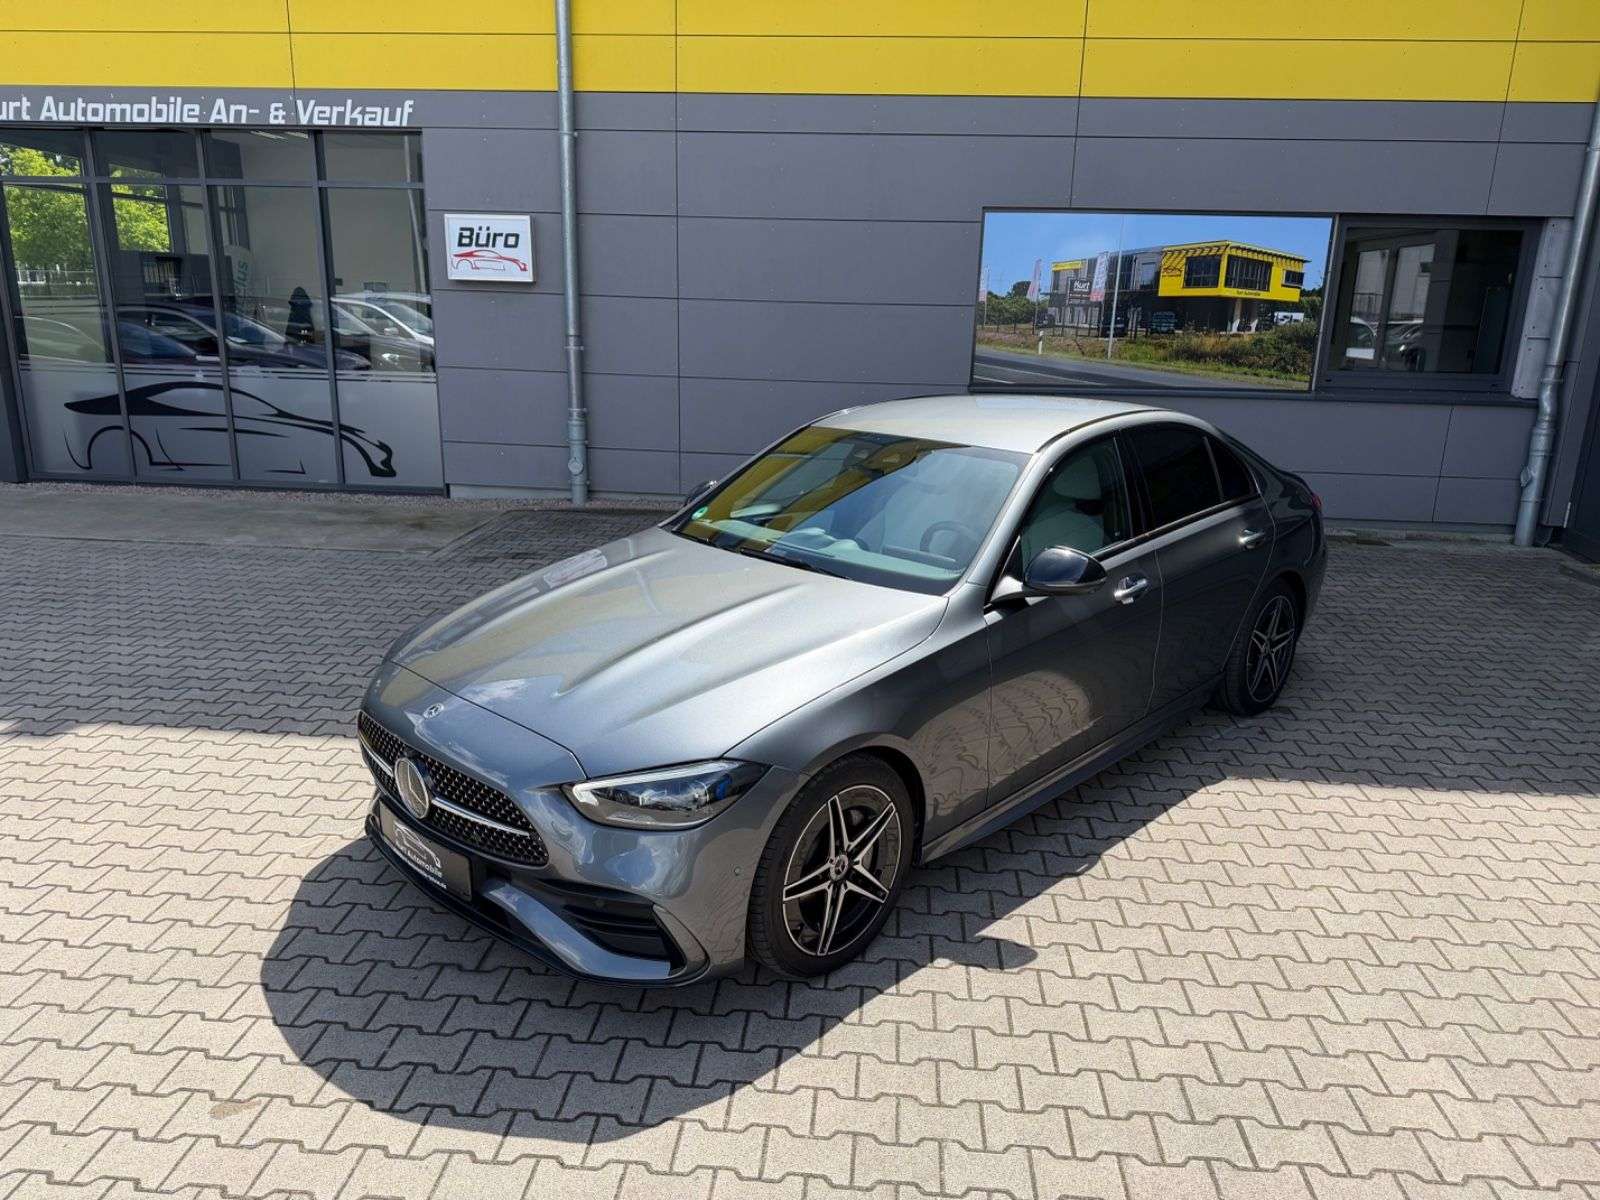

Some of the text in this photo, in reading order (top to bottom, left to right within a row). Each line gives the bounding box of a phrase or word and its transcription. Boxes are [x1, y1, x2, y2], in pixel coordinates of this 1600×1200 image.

[39, 96, 200, 123] Automobile
[209, 98, 260, 124] An-
[269, 102, 287, 124] &
[296, 99, 414, 127] Verkauf
[457, 226, 520, 248] Büro
